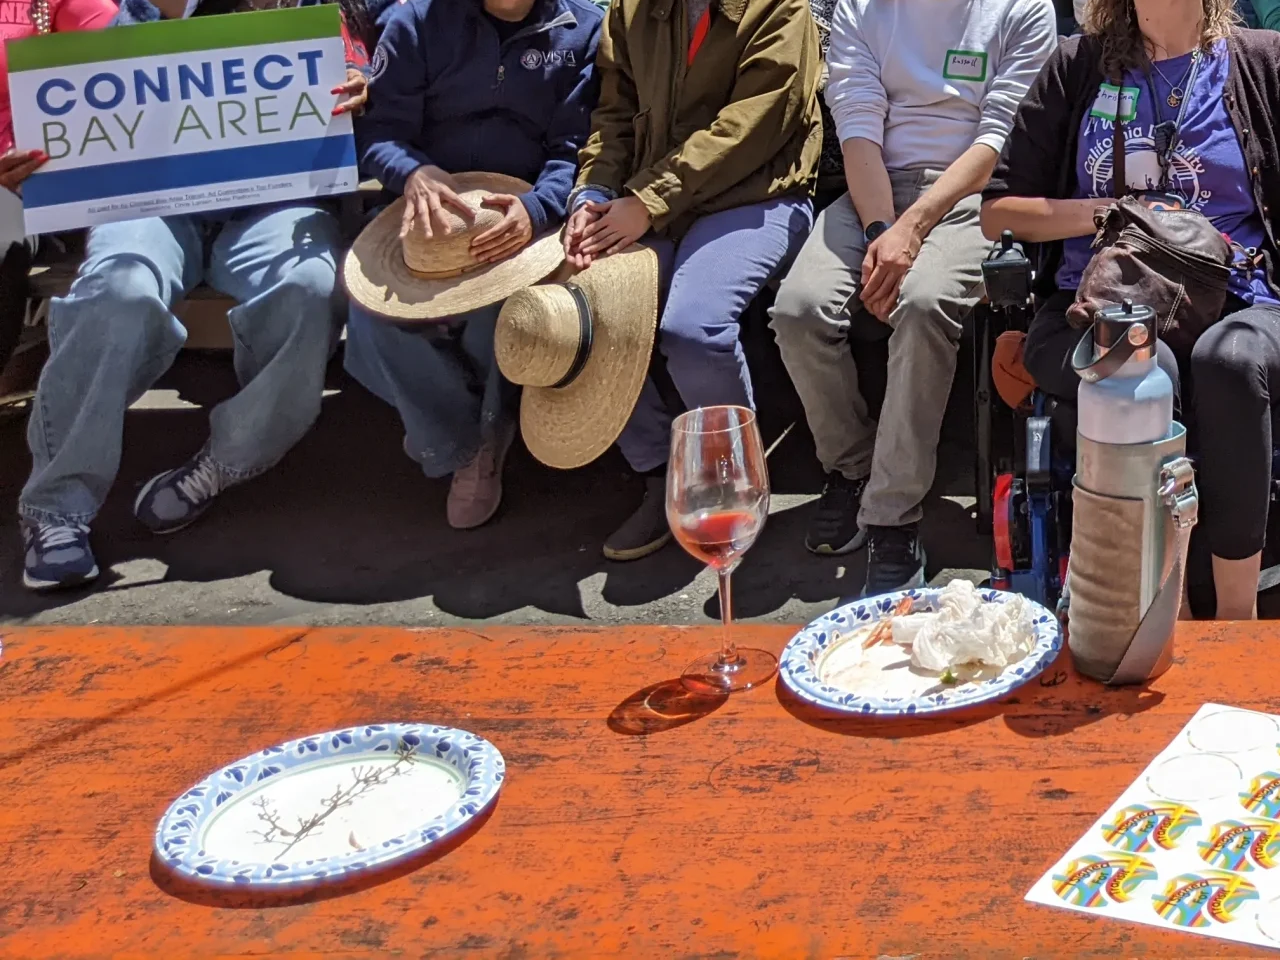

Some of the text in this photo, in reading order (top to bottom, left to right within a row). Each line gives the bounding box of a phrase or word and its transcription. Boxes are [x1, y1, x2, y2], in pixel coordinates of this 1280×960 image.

[542, 50, 576, 64] VISTA
[36, 50, 324, 116] CONNECT
[42, 91, 327, 160] BAY AREA
[1120, 809, 1156, 832] Signed
[1140, 820, 1156, 833] For
[1158, 816, 1175, 842] Transit
[1216, 826, 1252, 850] Signed
[1236, 836, 1252, 850] For
[1255, 834, 1272, 860] Transit
[1073, 861, 1110, 884] Signed
[1092, 872, 1109, 885] For
[1112, 870, 1128, 894] Transit
[1172, 880, 1210, 904] Signed
[1193, 890, 1209, 904] For
[1212, 889, 1230, 914] Transit
